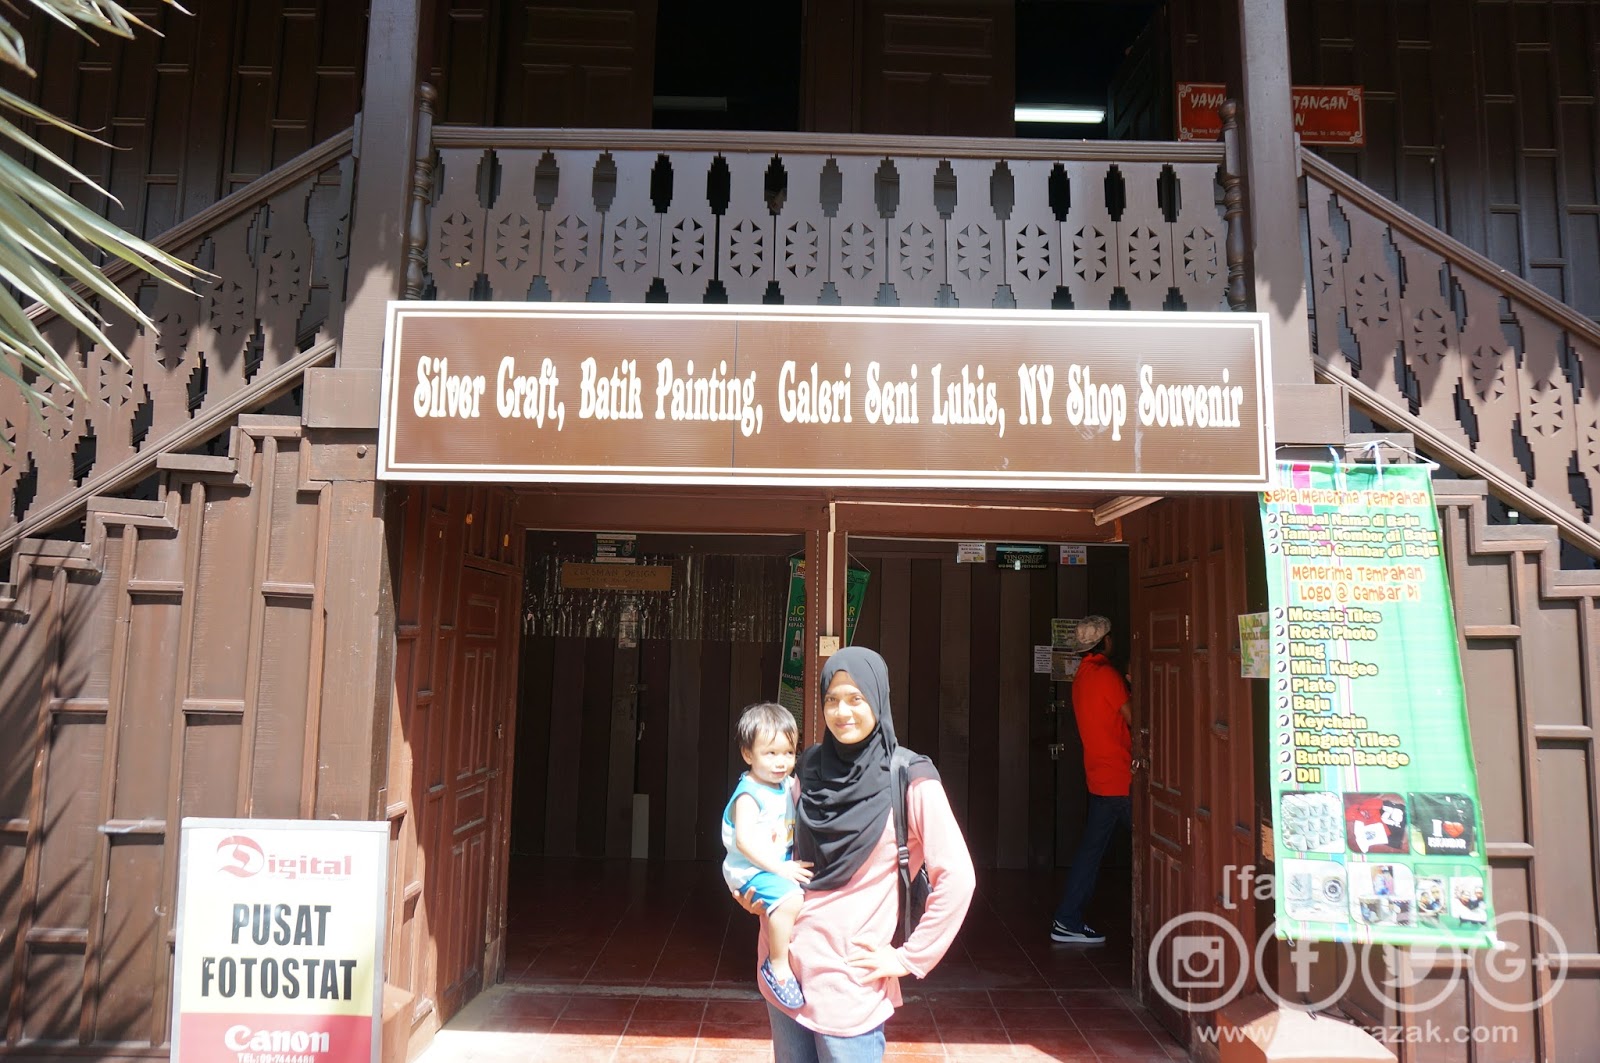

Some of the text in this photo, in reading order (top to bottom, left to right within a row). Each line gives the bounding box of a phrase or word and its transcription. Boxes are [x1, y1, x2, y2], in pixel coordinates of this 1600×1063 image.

[1190, 93, 1227, 109] YAYA
[1293, 95, 1349, 110] TANGAN
[413, 355, 1244, 441] Silver Craft, Batik Painting, Galeri Seni Lukis, NY Shop Souvenir
[1280, 511, 1420, 528] Tampal Nama di Baju
[1280, 527, 1438, 543] Tampal Nombor di Baju
[1281, 542, 1440, 559] Tampal Gambar di Baju
[1336, 582, 1349, 602] @
[1287, 607, 1382, 623] Mosaic Tiles
[1288, 624, 1331, 640] Rock
[1331, 625, 1378, 641] Photo
[1289, 642, 1326, 660] Mug
[1290, 660, 1379, 678] Mini Kugee
[1291, 677, 1336, 693] Plate
[1292, 695, 1332, 714] Baju
[1293, 713, 1368, 732] Keychain
[1294, 731, 1400, 750] Magnet Tiles
[1295, 749, 1410, 769] Button Badge
[216, 835, 352, 880] Digital
[231, 903, 332, 946] PUSAT
[201, 956, 357, 1001] FOTOSTAT
[224, 1024, 330, 1053] Canon
